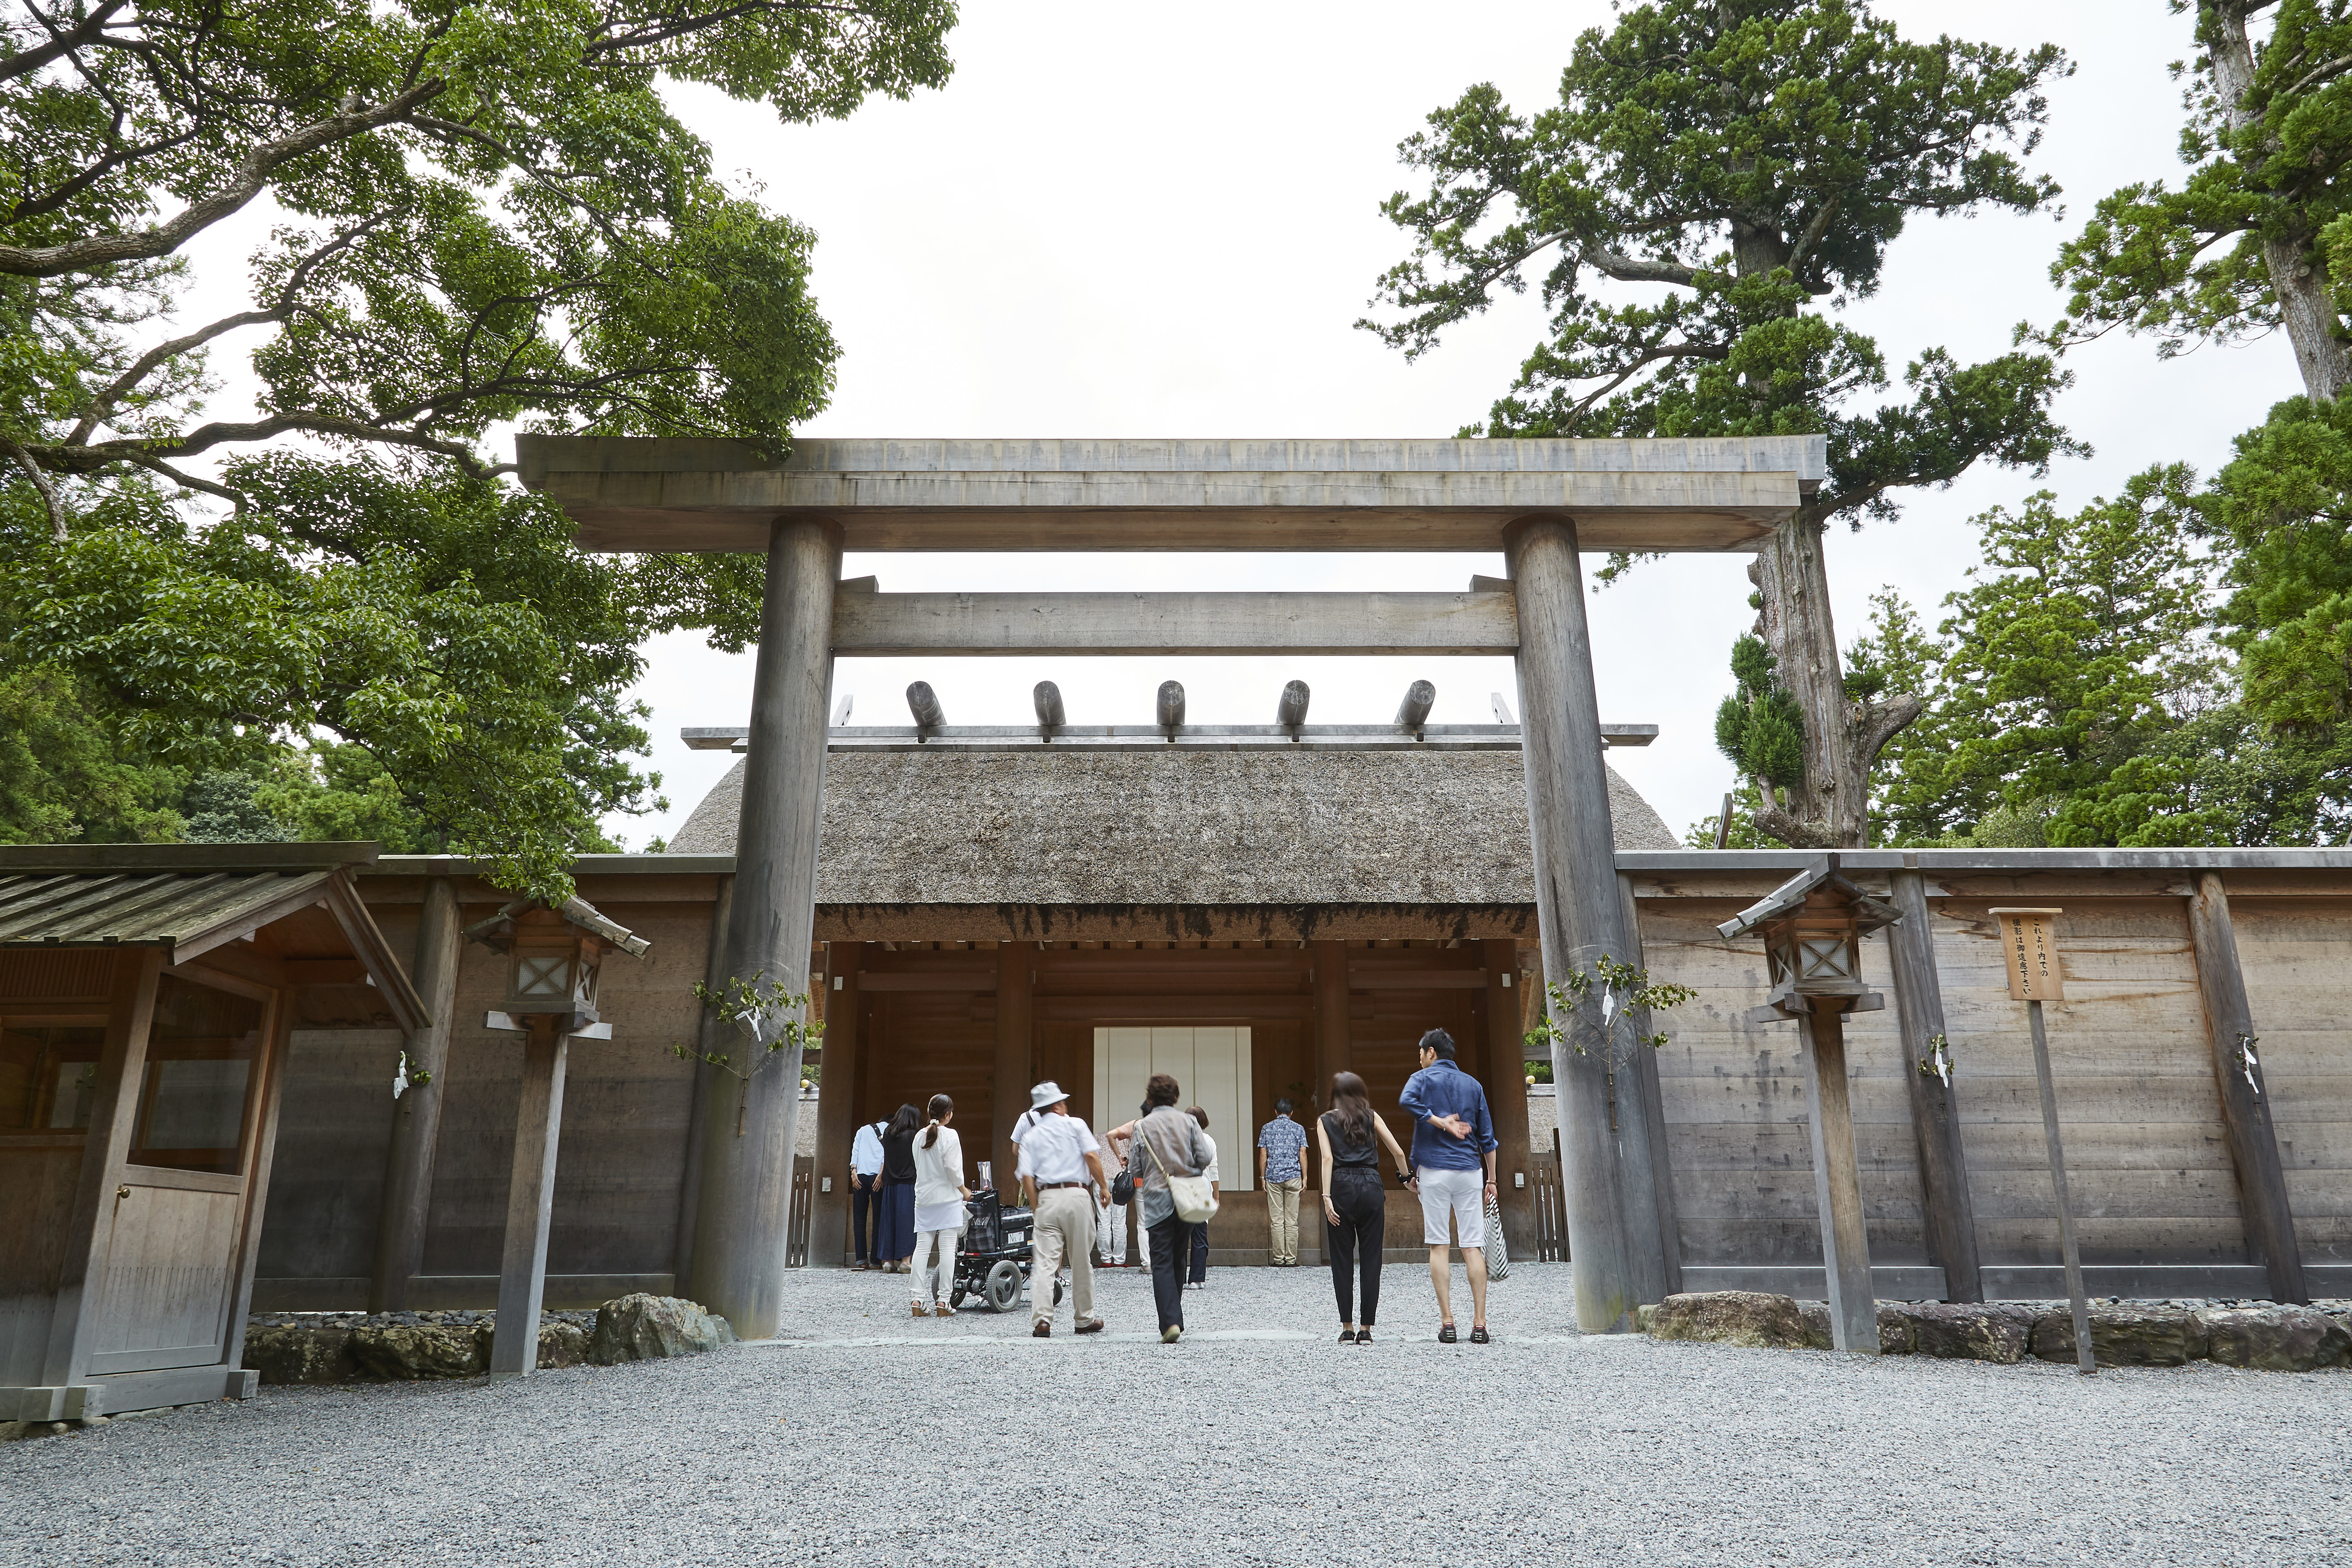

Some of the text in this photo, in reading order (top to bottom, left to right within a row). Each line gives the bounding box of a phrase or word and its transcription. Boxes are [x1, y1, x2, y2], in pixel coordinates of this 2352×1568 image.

[2012, 918, 2031, 994] 撮影は御遠慮下さい
[2033, 918, 2048, 977] これより内での
[1019, 1232, 1022, 1241] 7
